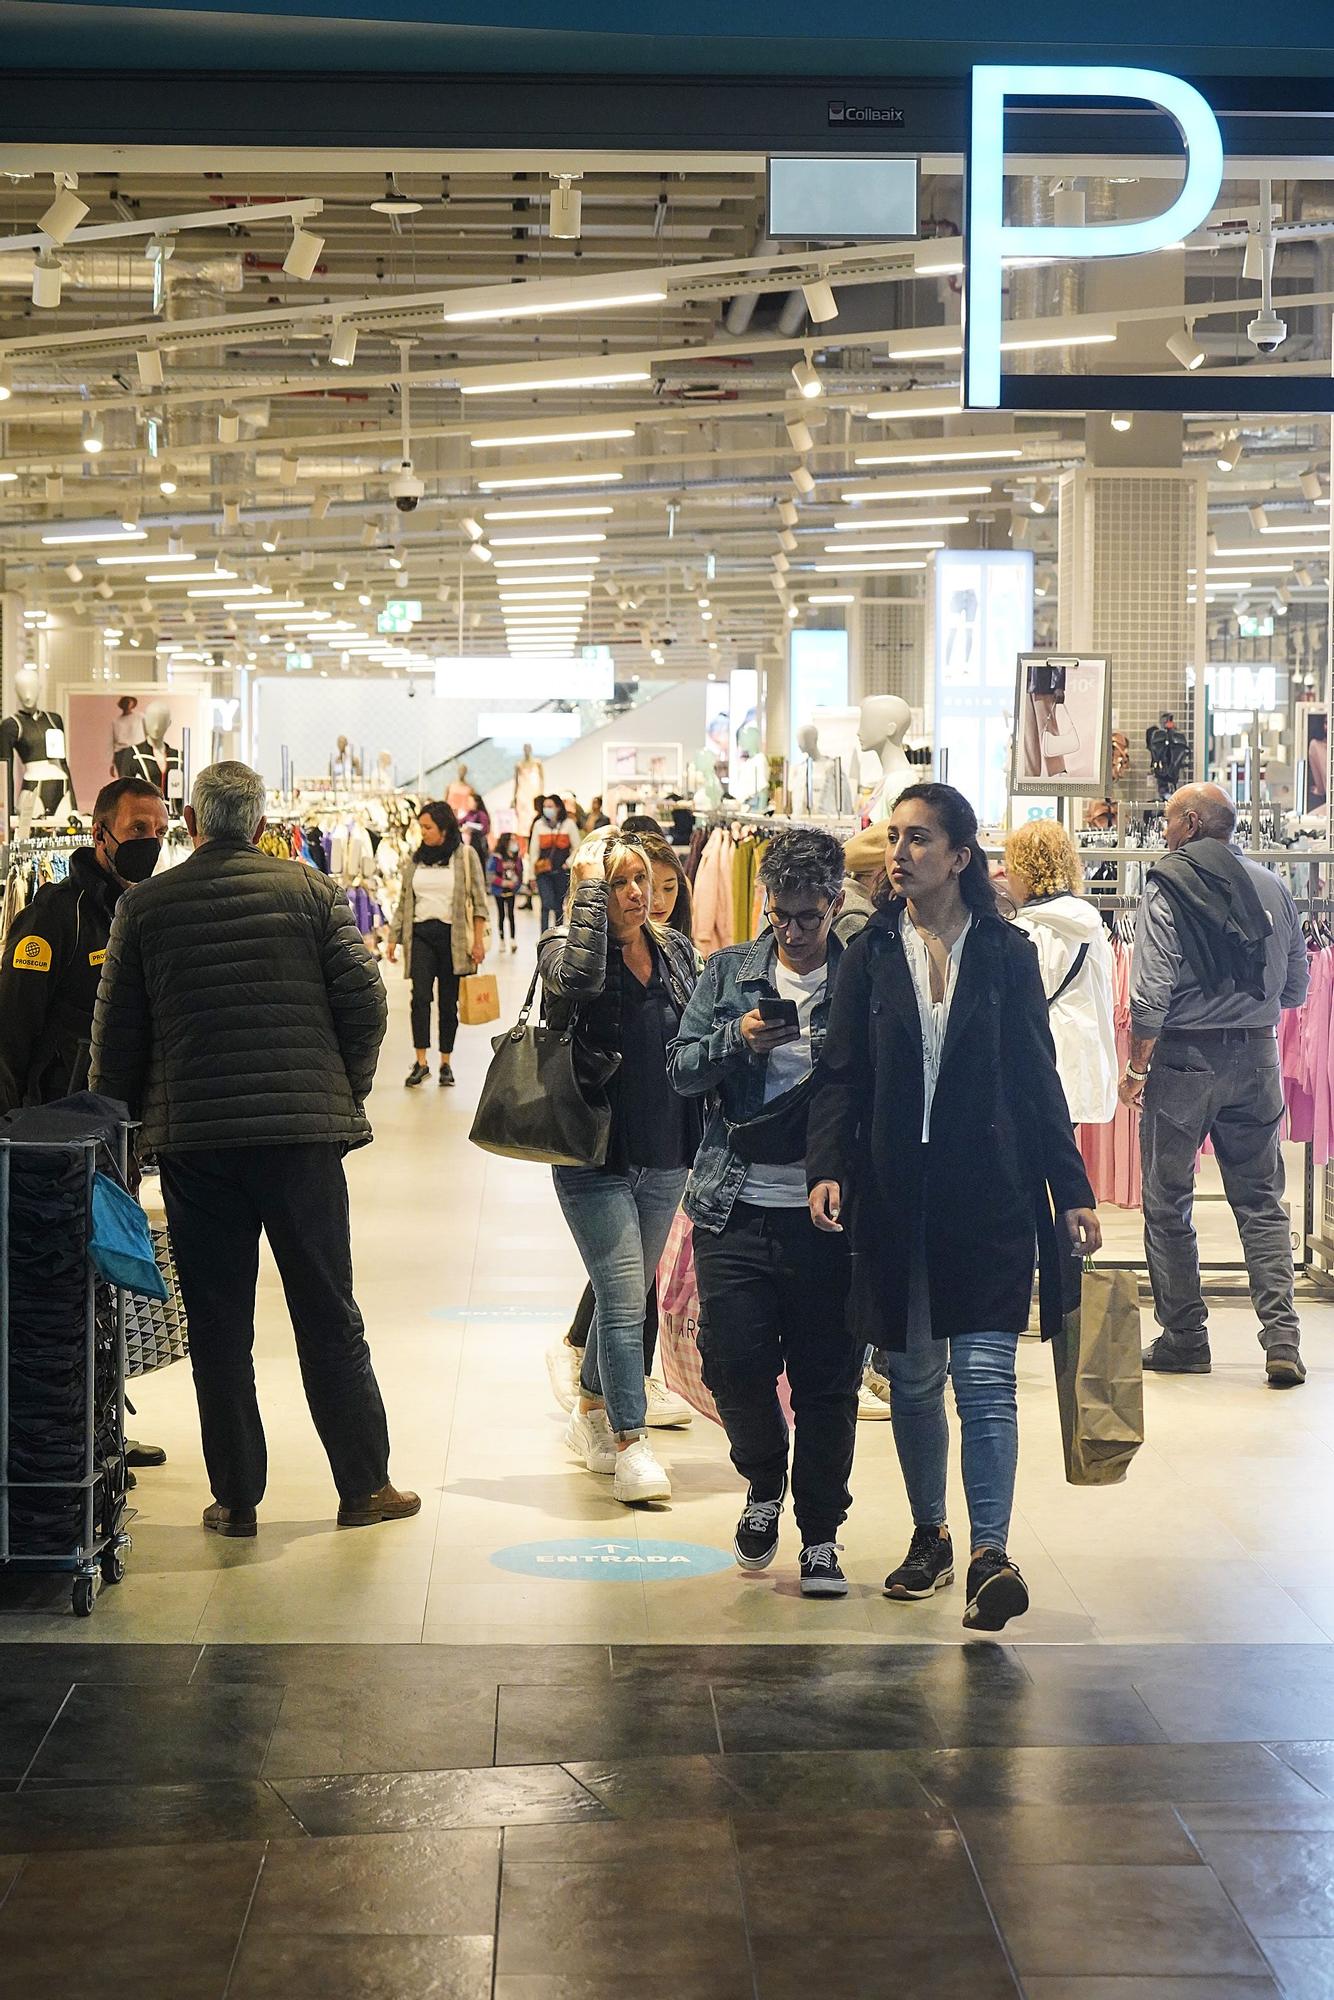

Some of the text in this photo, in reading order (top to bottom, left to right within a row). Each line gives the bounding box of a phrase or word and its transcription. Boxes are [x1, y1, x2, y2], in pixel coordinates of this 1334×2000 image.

[969, 65, 1224, 407] P
[15, 958, 48, 968] PROSEGUR
[535, 1555, 692, 1563] ENTRADA
